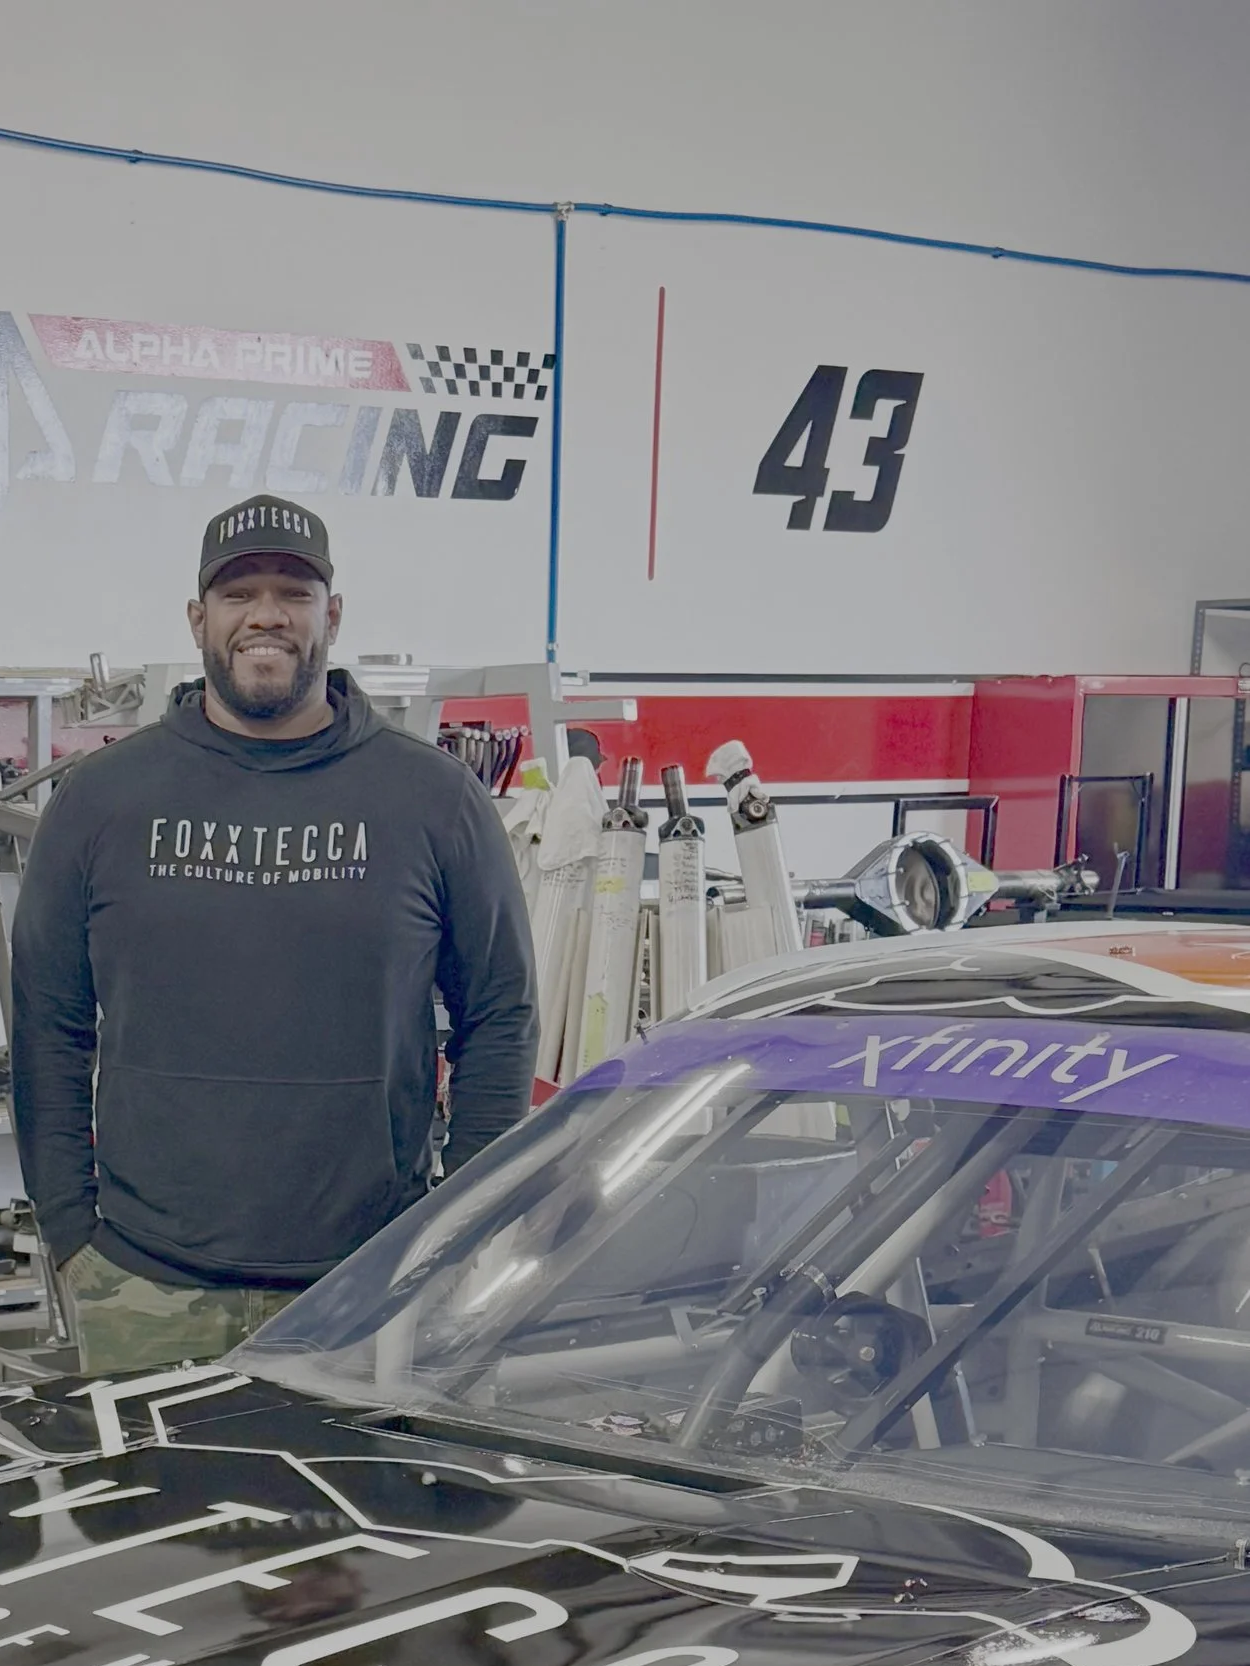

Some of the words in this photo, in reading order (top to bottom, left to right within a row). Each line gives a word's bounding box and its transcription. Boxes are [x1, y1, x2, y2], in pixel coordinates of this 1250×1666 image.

[72, 327, 221, 373] ALPHA
[235, 338, 375, 379] PRIME
[92, 390, 539, 502] RACING
[752, 364, 925, 534] 43
[219, 506, 312, 545] FOXXTECCA
[150, 818, 368, 866] FOXXTECCA
[150, 864, 177, 877] THE
[184, 864, 255, 885] CULTURE
[261, 871, 282, 885] OF
[288, 866, 367, 884] MOBILITY
[829, 1024, 1180, 1103] xfinity
